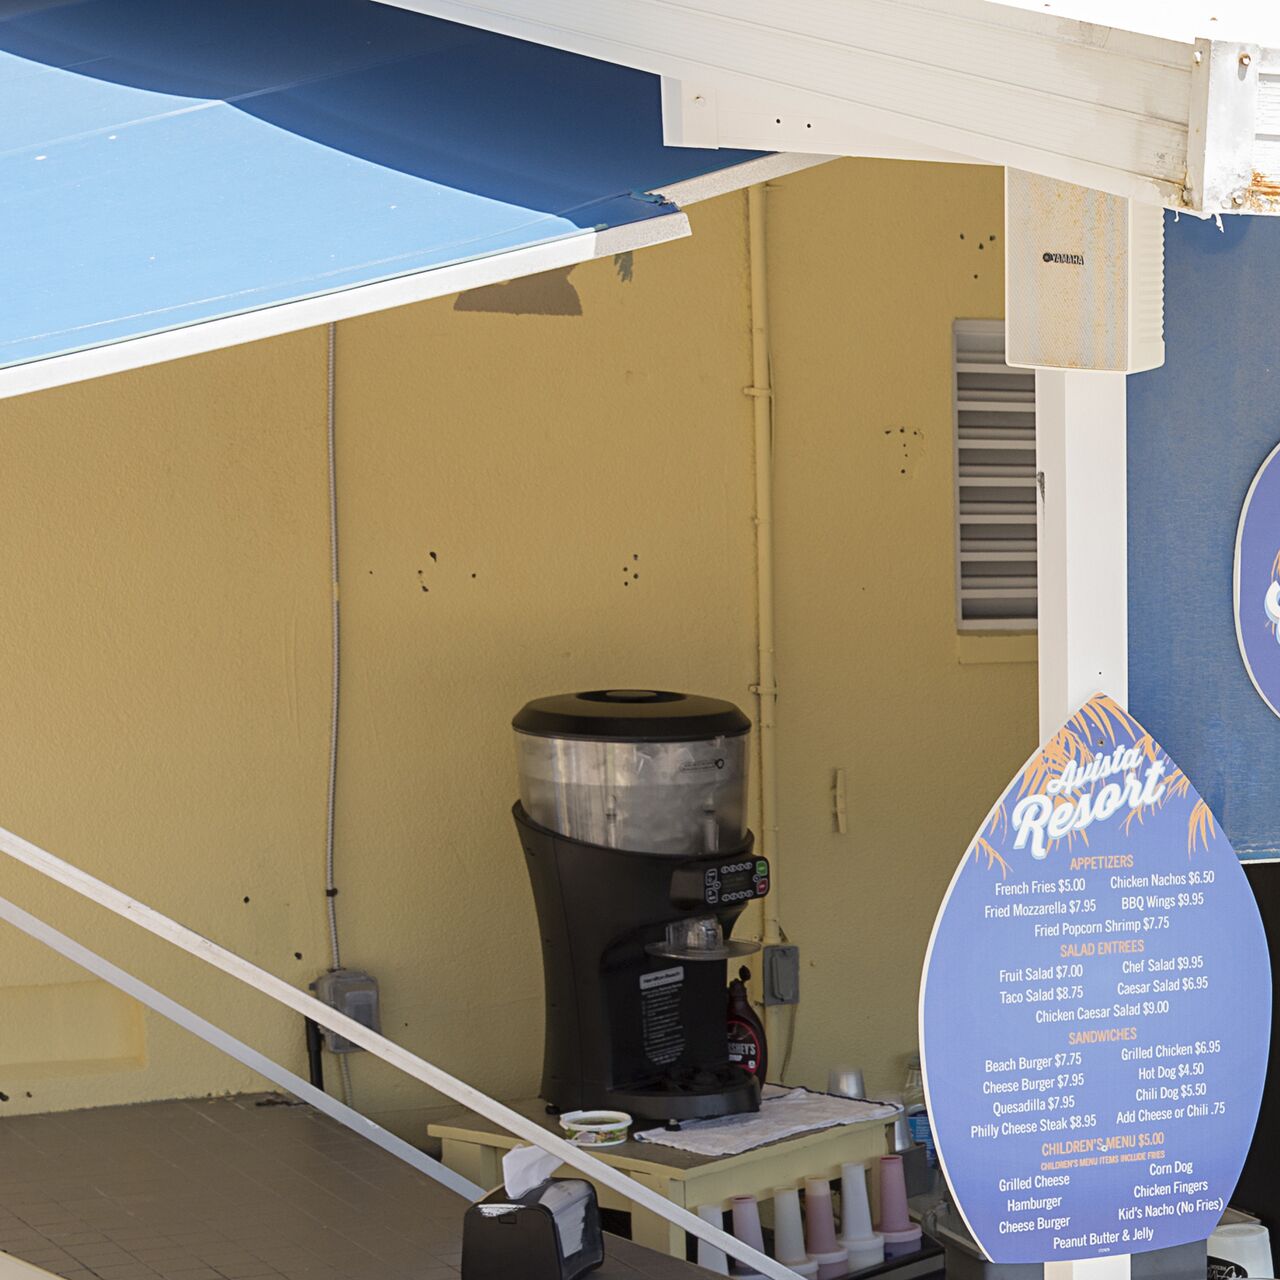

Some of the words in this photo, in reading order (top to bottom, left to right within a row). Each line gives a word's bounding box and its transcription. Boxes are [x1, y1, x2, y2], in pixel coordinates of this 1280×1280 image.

[1046, 744, 1144, 796] Avista
[1012, 760, 1166, 860] Resort
[1069, 853, 1135, 871] APPETIZERS
[995, 881, 1029, 896] French
[1031, 880, 1057, 894] Fries
[1057, 877, 1086, 894] $5.00
[1110, 874, 1149, 889] Chicken
[1151, 872, 1187, 887] Nachos
[1187, 869, 1215, 886] $6.50
[1059, 942, 1095, 959] SALAD
[1097, 939, 1145, 956] ENTREES
[1068, 1026, 1137, 1045] SANDWICHES
[1121, 1045, 1153, 1061] Grilled
[1155, 1043, 1193, 1058] Chicken
[1194, 1039, 1221, 1056] $6.95
[985, 1057, 1017, 1073] Beach
[1018, 1056, 1053, 1071] Burger
[1054, 1051, 1082, 1069] $7.75
[1041, 1137, 1103, 1157] CHILDREN'S
[1105, 1134, 1136, 1150] MENU
[1137, 1132, 1165, 1148] $5.00
[1118, 1206, 1143, 1221] Kid's
[1144, 1203, 1175, 1218] Nacho
[1175, 1200, 1195, 1217] (No
[1195, 1197, 1224, 1212] Fries)
[1053, 1233, 1088, 1250] Peanut
[1089, 1231, 1121, 1246] Butter
[1121, 1228, 1131, 1242] &
[1132, 1226, 1155, 1242] Jelly
